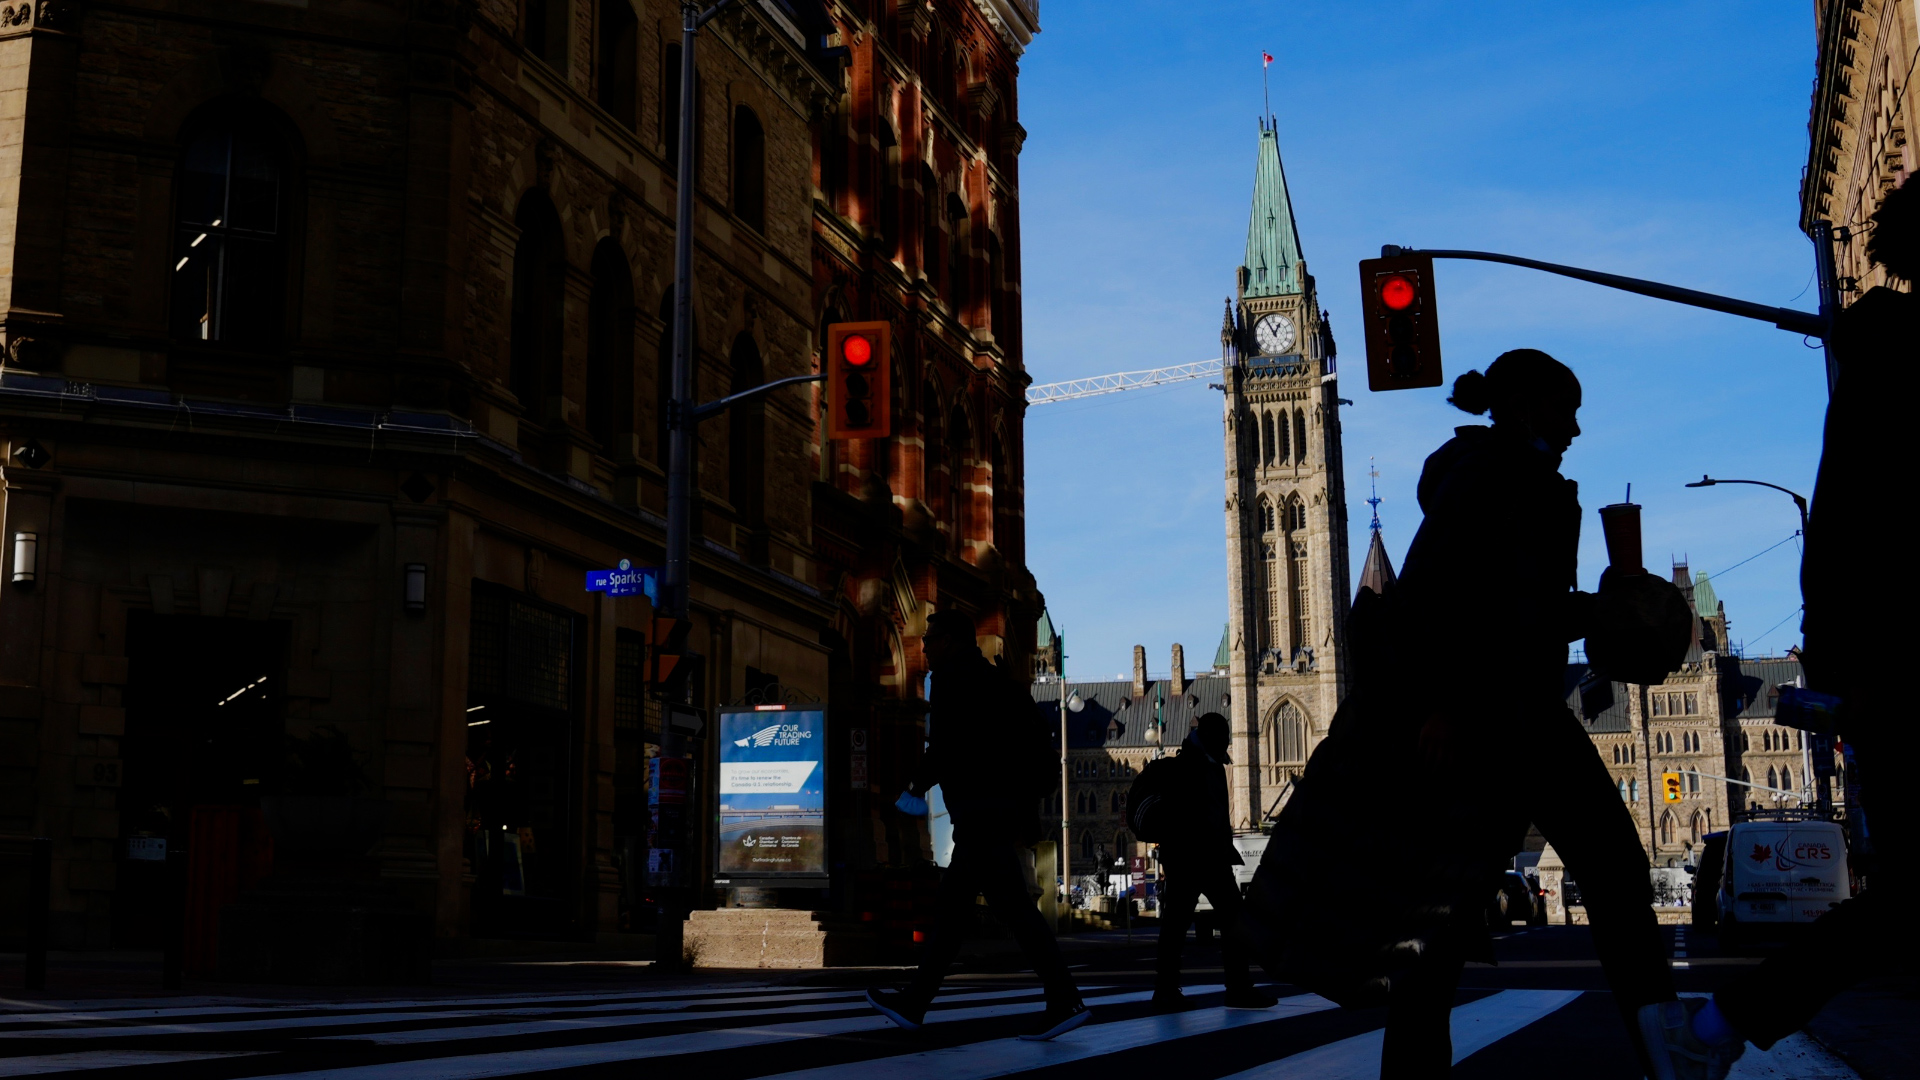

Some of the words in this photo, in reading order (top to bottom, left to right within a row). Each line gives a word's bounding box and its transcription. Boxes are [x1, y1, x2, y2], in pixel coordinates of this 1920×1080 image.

[609, 570, 642, 588] Sparks
[1815, 739, 1829, 752] H
[93, 763, 118, 782] 93
[1795, 848, 1831, 859] CRS
